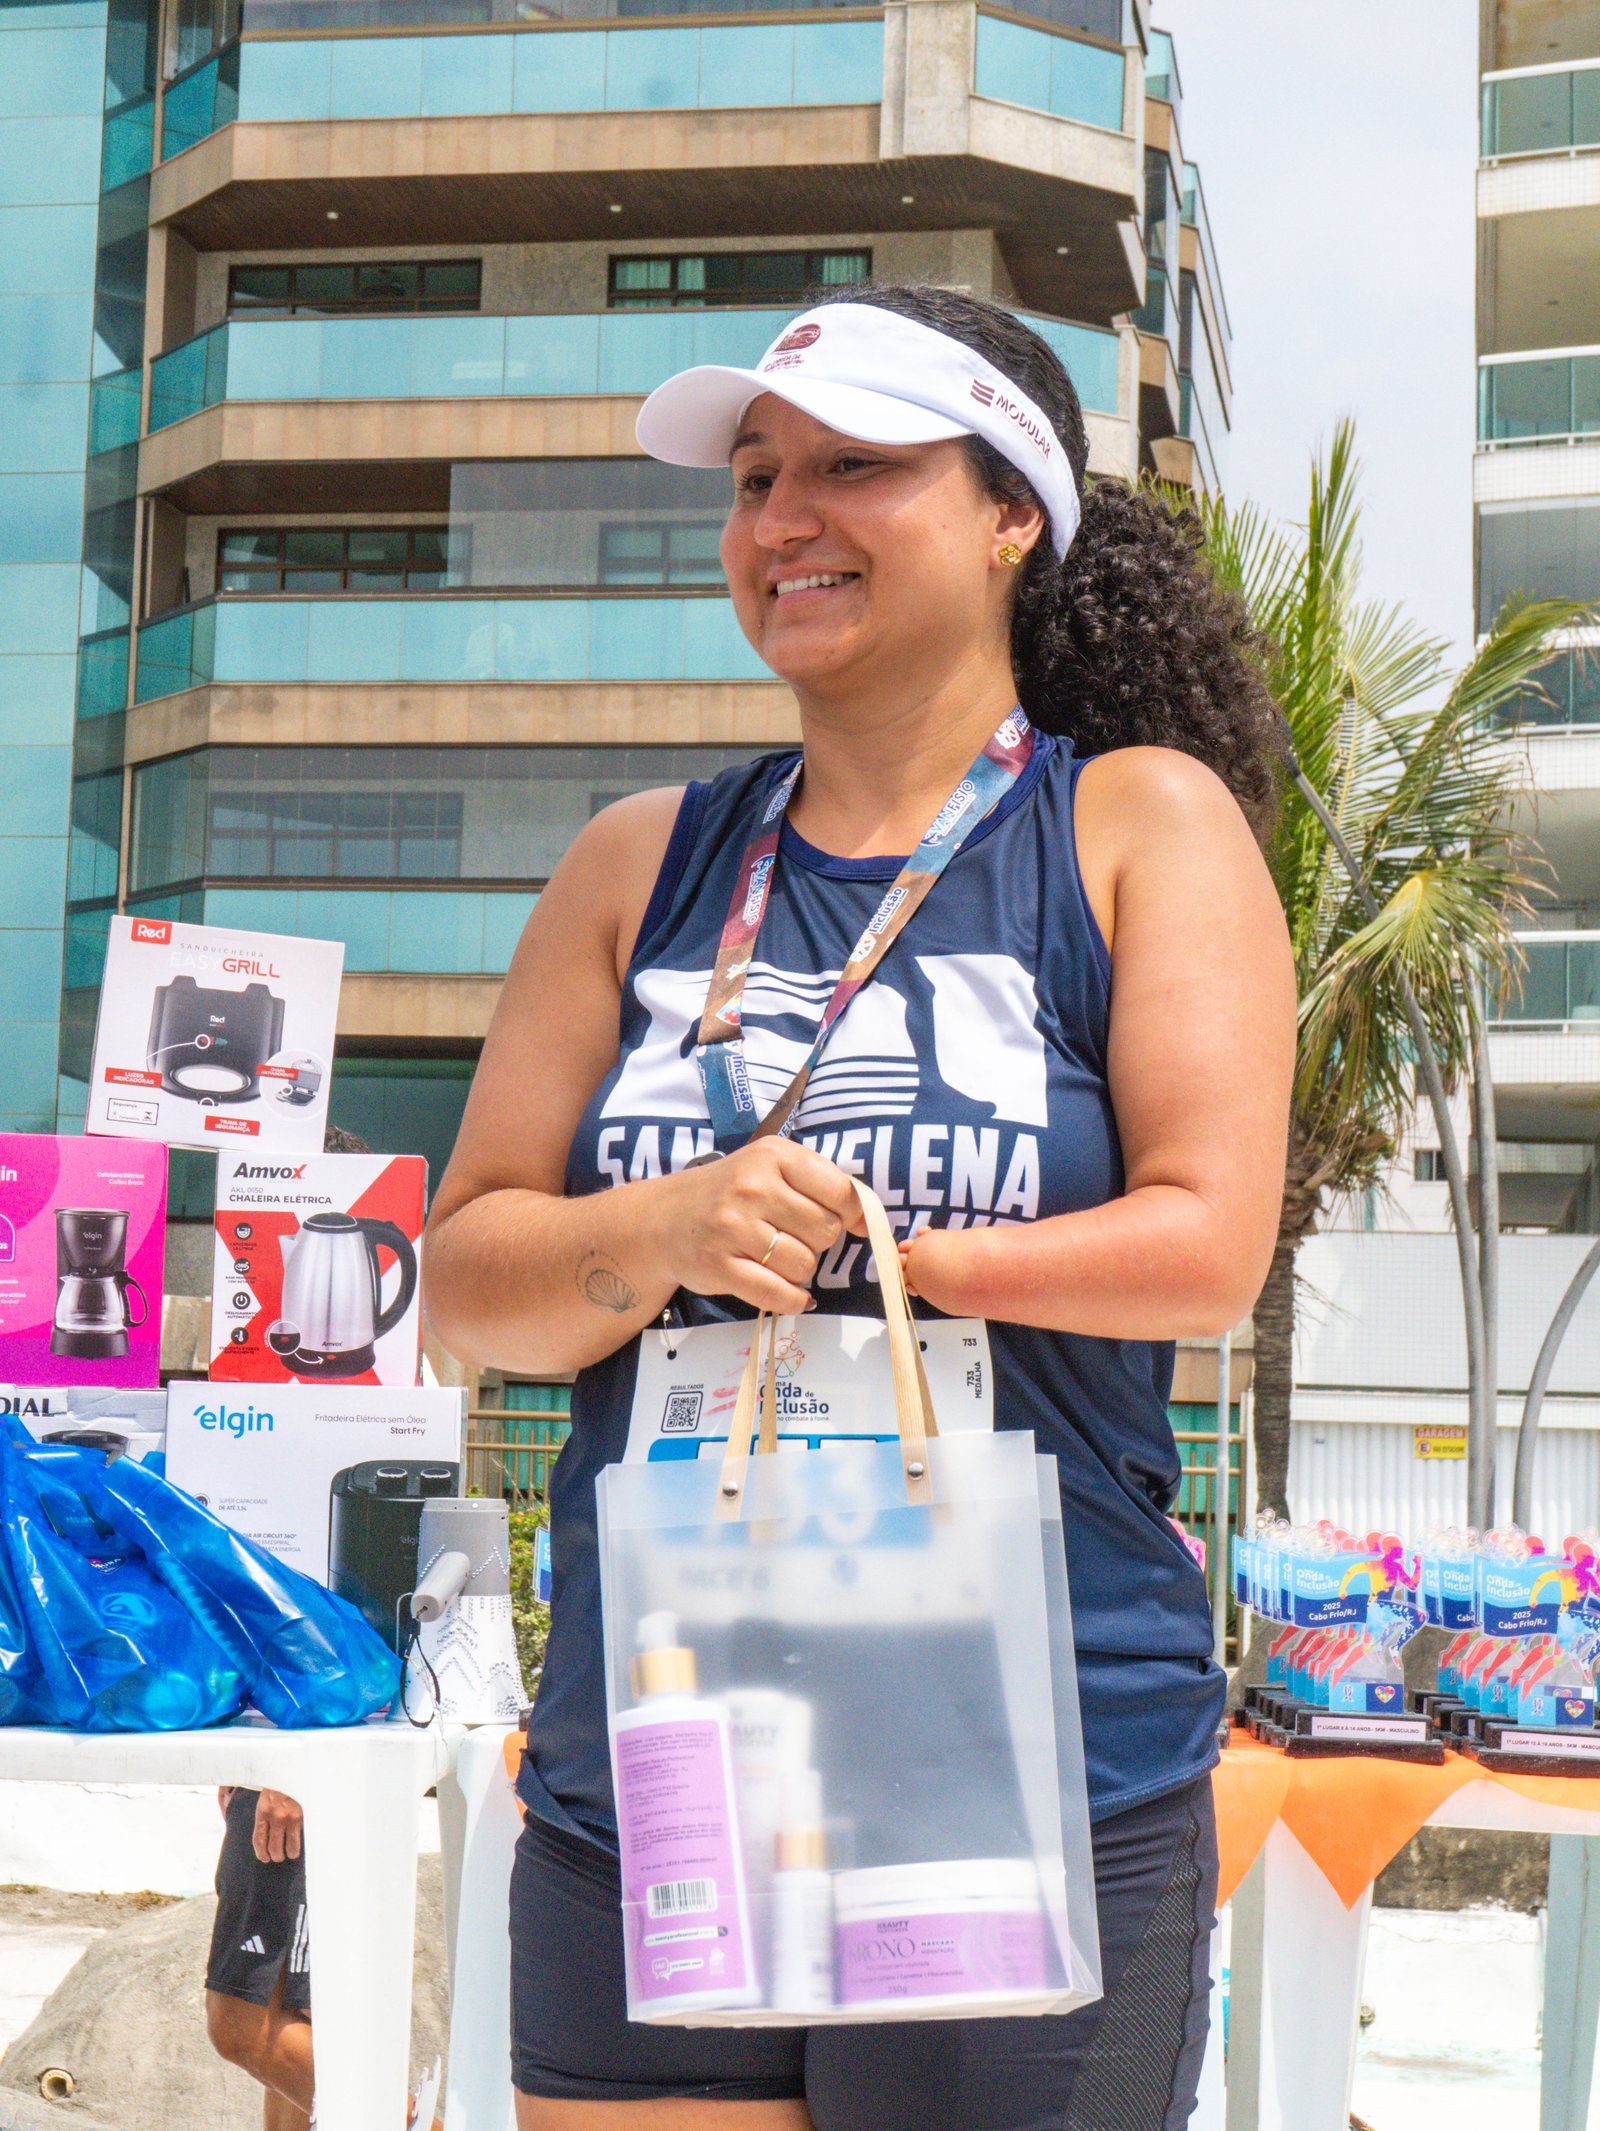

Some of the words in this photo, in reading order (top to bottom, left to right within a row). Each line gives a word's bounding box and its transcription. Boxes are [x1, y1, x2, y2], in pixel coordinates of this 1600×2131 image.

[995, 394, 1051, 460] MODULAR
[868, 887, 903, 933] Inclusão
[137, 923, 166, 940] Red
[180, 943, 264, 958] SANDUICHEIRA
[222, 957, 281, 978] GRILL
[210, 1015, 225, 1024] Red
[113, 1075, 155, 1085] INDICADORAS
[731, 1055, 754, 1111] Inclusão
[214, 1123, 251, 1133] SEGURANÇA
[597, 1125, 715, 1191] SAN
[232, 1162, 308, 1180] Amvox
[229, 1194, 281, 1203] CHALEIRA
[283, 1194, 333, 1204] ELÉTRICA
[962, 1338, 977, 1346] 733
[966, 1370, 975, 1386] 733
[974, 1361, 982, 1399] MEDALHA
[670, 1383, 704, 1391] RESULTADOS
[0, 1397, 55, 1417] DIAL
[759, 1399, 830, 1414] Iclusão
[193, 1404, 274, 1439] elgin
[315, 1413, 355, 1423] Fritadeira
[356, 1414, 386, 1423] Elétrica
[388, 1416, 405, 1424] sem
[406, 1414, 427, 1424] Óleo
[390, 1426, 410, 1435] Start
[412, 1426, 426, 1436] Fry
[1417, 1428, 1463, 1438] GARAGEM
[1296, 1569, 1325, 1582] Onda
[1486, 1574, 1515, 1588] Onda
[1297, 1578, 1340, 1591] Inclusão
[1486, 1585, 1530, 1598] Inclusão
[1323, 1602, 1341, 1611] 2025
[1309, 1612, 1328, 1621] Cabo
[1329, 1609, 1357, 1619] Frio/RJ
[1513, 1611, 1531, 1619] 2025
[1498, 1620, 1518, 1629] Cabo
[1519, 1618, 1548, 1628] Frio/RJ
